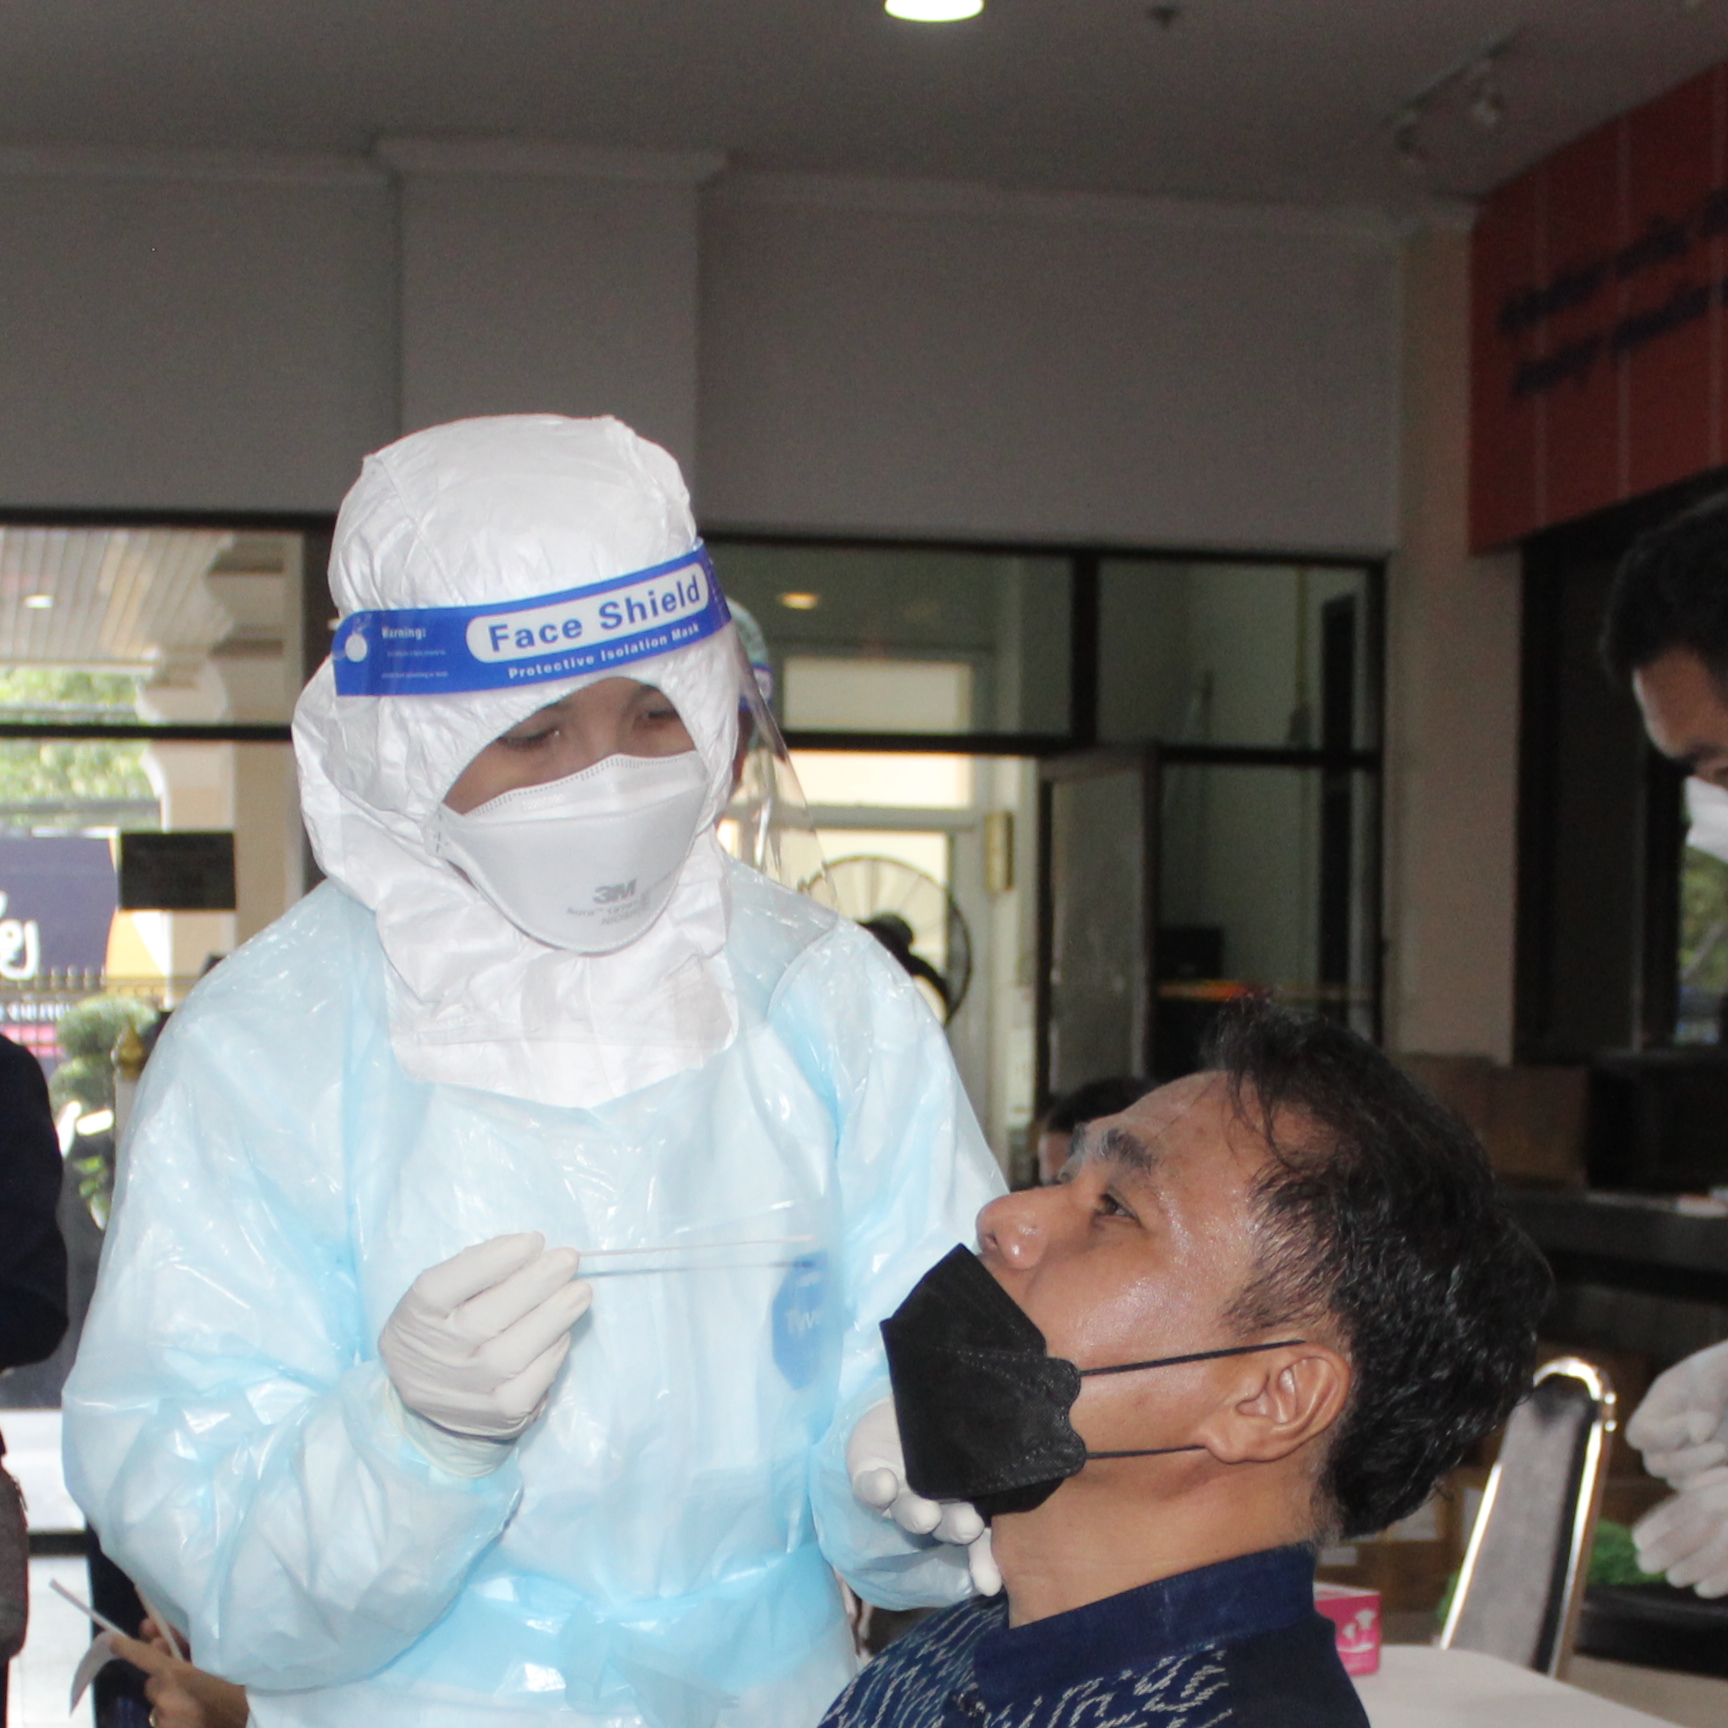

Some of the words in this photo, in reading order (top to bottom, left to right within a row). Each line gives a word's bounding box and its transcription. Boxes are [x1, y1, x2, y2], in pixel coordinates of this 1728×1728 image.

[488, 617, 583, 653] Face
[598, 574, 701, 630] Shield
[508, 655, 595, 679] Protective
[600, 636, 668, 662] Isolation
[671, 622, 701, 642] Mask
[592, 878, 637, 905] 3M
